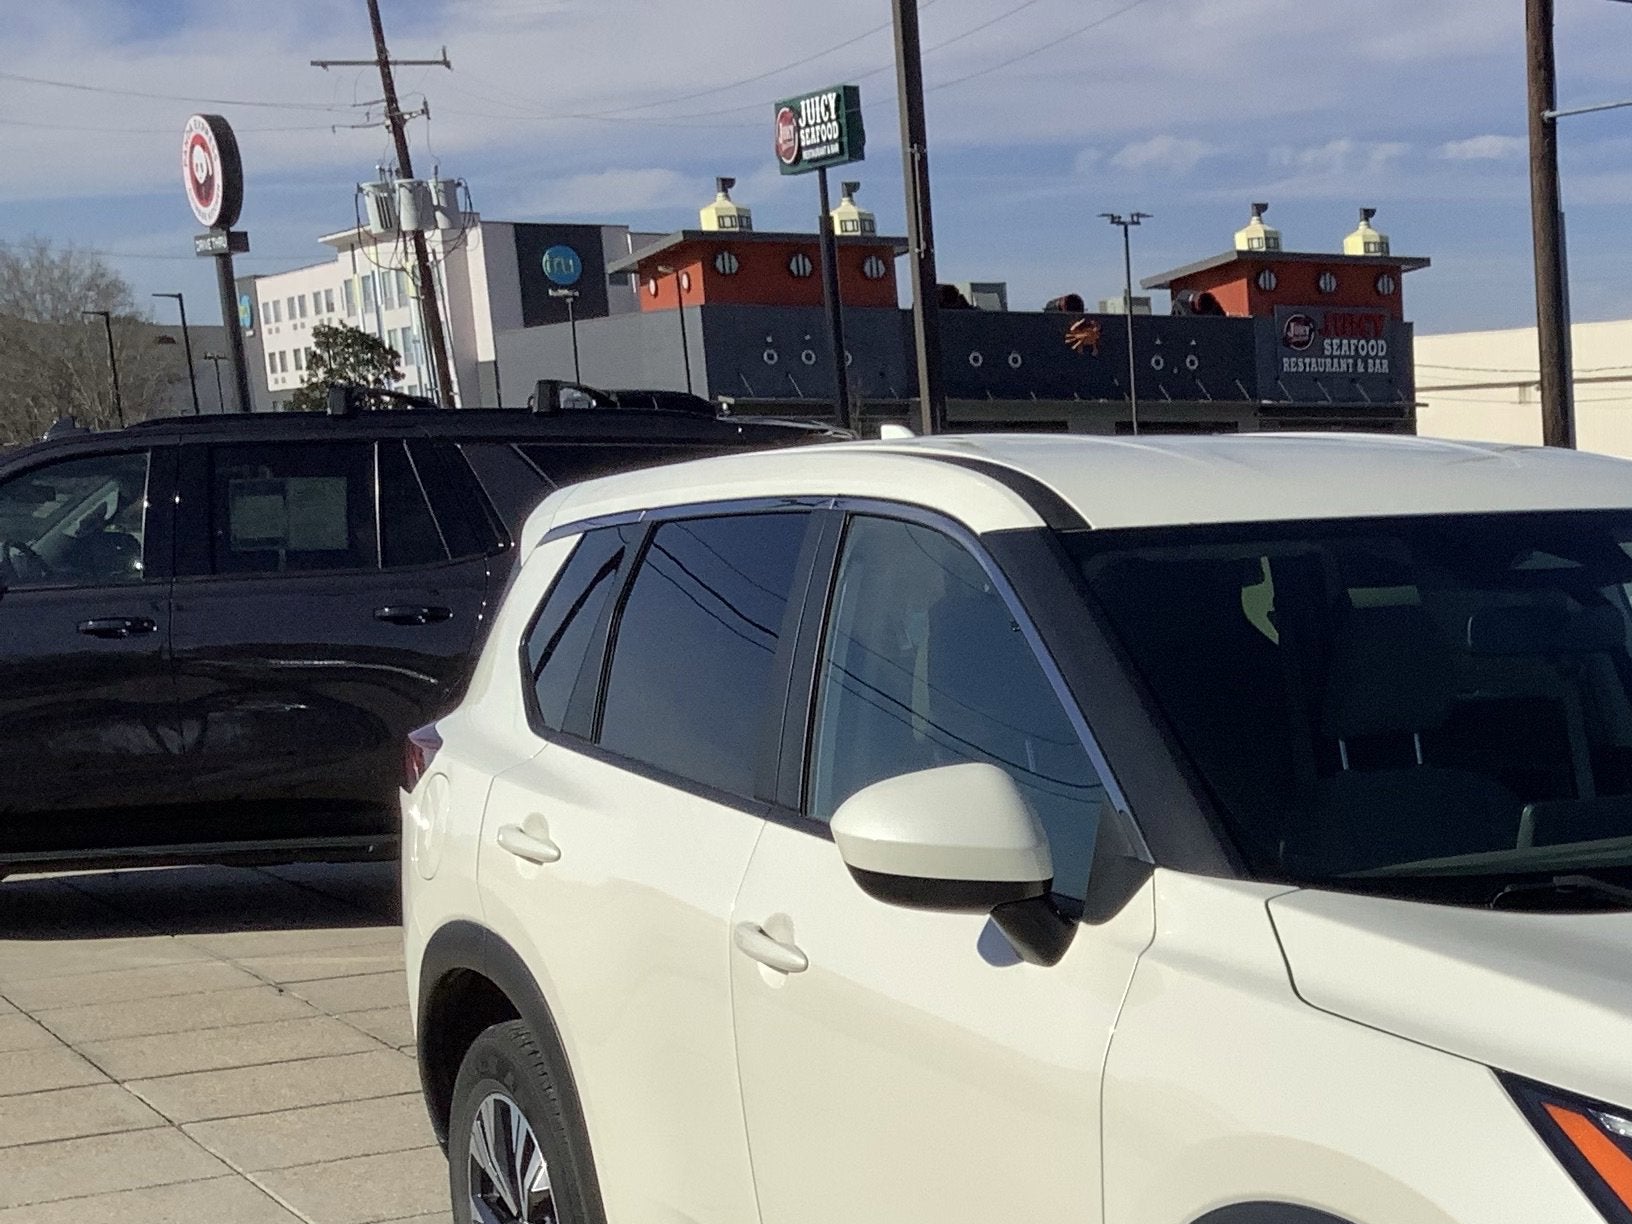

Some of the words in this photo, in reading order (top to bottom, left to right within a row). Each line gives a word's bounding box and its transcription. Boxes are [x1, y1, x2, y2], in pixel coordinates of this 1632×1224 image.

[798, 92, 837, 128] JUICY
[800, 121, 840, 147] SEAFOOD
[1323, 338, 1388, 357] SEAFOOD
[1282, 357, 1354, 373] RESTAURANT
[1357, 358, 1366, 373] &
[1367, 359, 1390, 374] BAR
